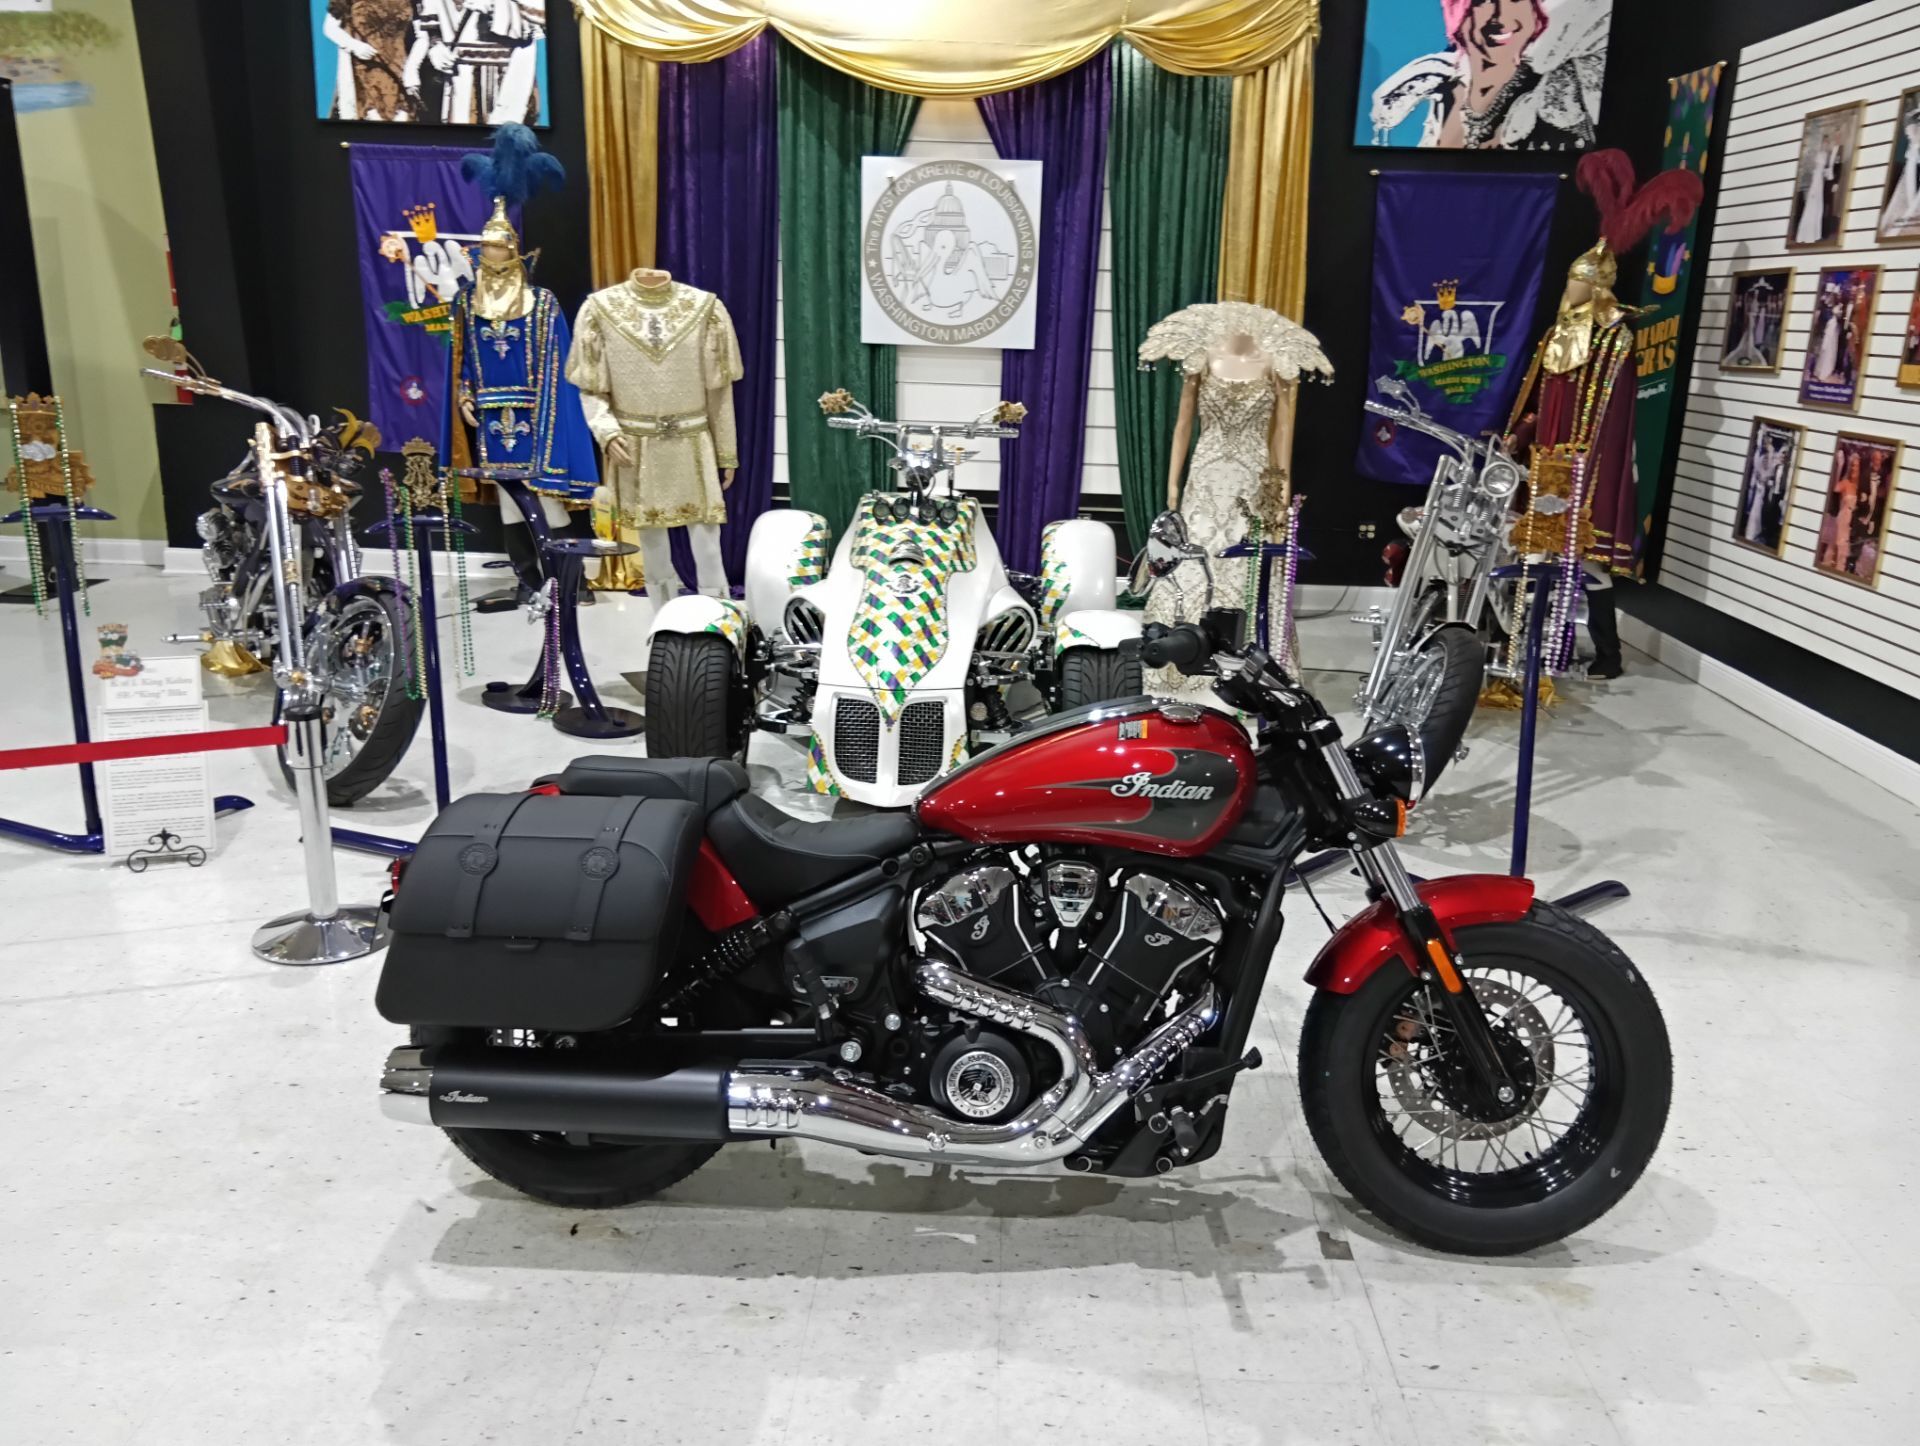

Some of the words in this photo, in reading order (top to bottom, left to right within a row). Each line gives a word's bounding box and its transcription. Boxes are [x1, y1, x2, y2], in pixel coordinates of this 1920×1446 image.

[866, 231, 879, 253] The
[873, 175, 916, 227] MYSTICK
[917, 164, 966, 179] KREWE
[968, 167, 980, 179] of
[982, 172, 1034, 259] LOUISIANIANS
[401, 304, 451, 323] WASHI
[870, 272, 950, 341] WASHINGTON
[953, 317, 1000, 341] MARDI
[1000, 277, 1029, 317] GRAS
[1637, 314, 1680, 349] MARDI
[1417, 356, 1490, 378] WASHINGTON
[1110, 771, 1215, 800] Indian
[439, 1090, 489, 1103] Indian
